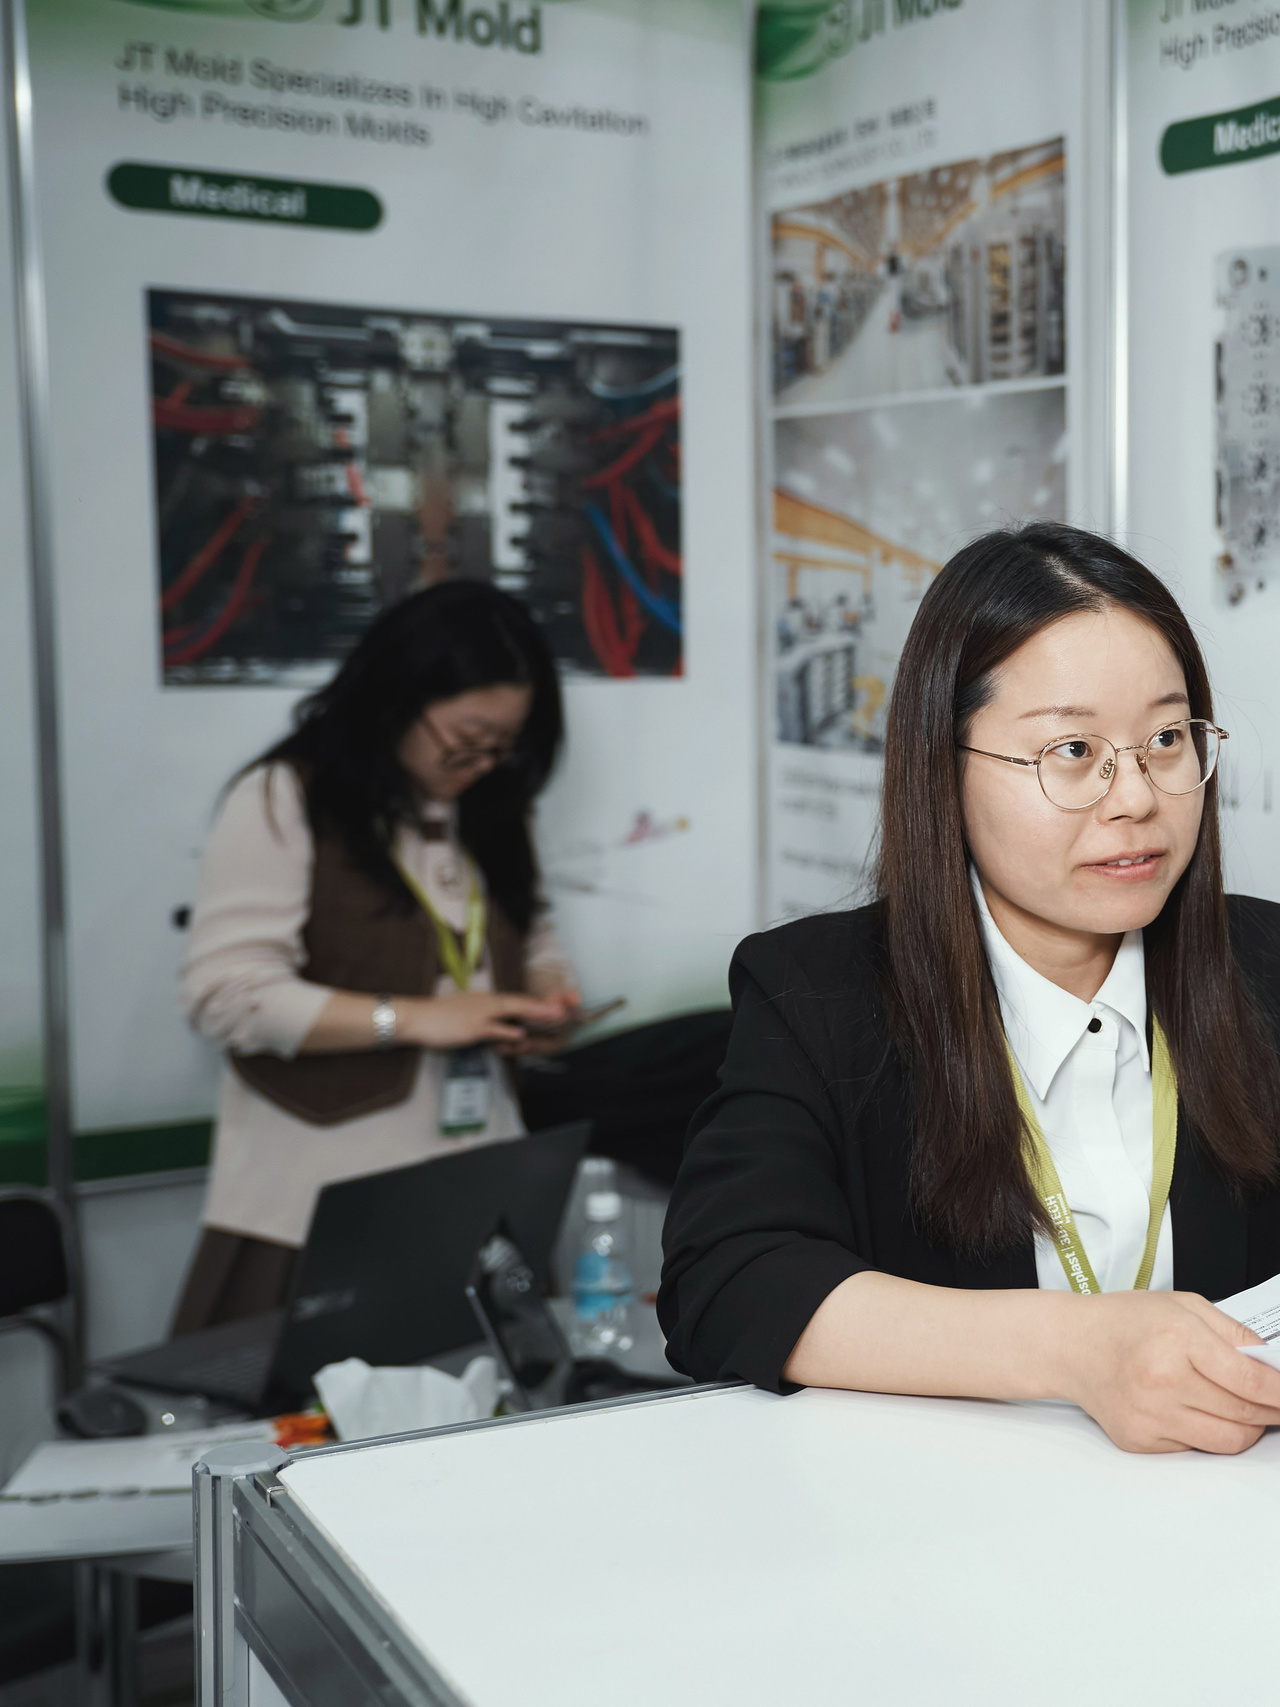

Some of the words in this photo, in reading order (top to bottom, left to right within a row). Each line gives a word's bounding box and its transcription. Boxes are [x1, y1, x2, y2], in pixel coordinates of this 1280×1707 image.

[415, 0, 541, 53] Mold
[1159, 33, 1208, 70] High
[114, 42, 156, 73] JT
[165, 45, 243, 86] Mold
[249, 57, 414, 110] Specializes
[117, 81, 195, 124] High
[202, 90, 336, 136] Precision
[344, 108, 432, 147] Molds
[168, 174, 307, 220] Medical
